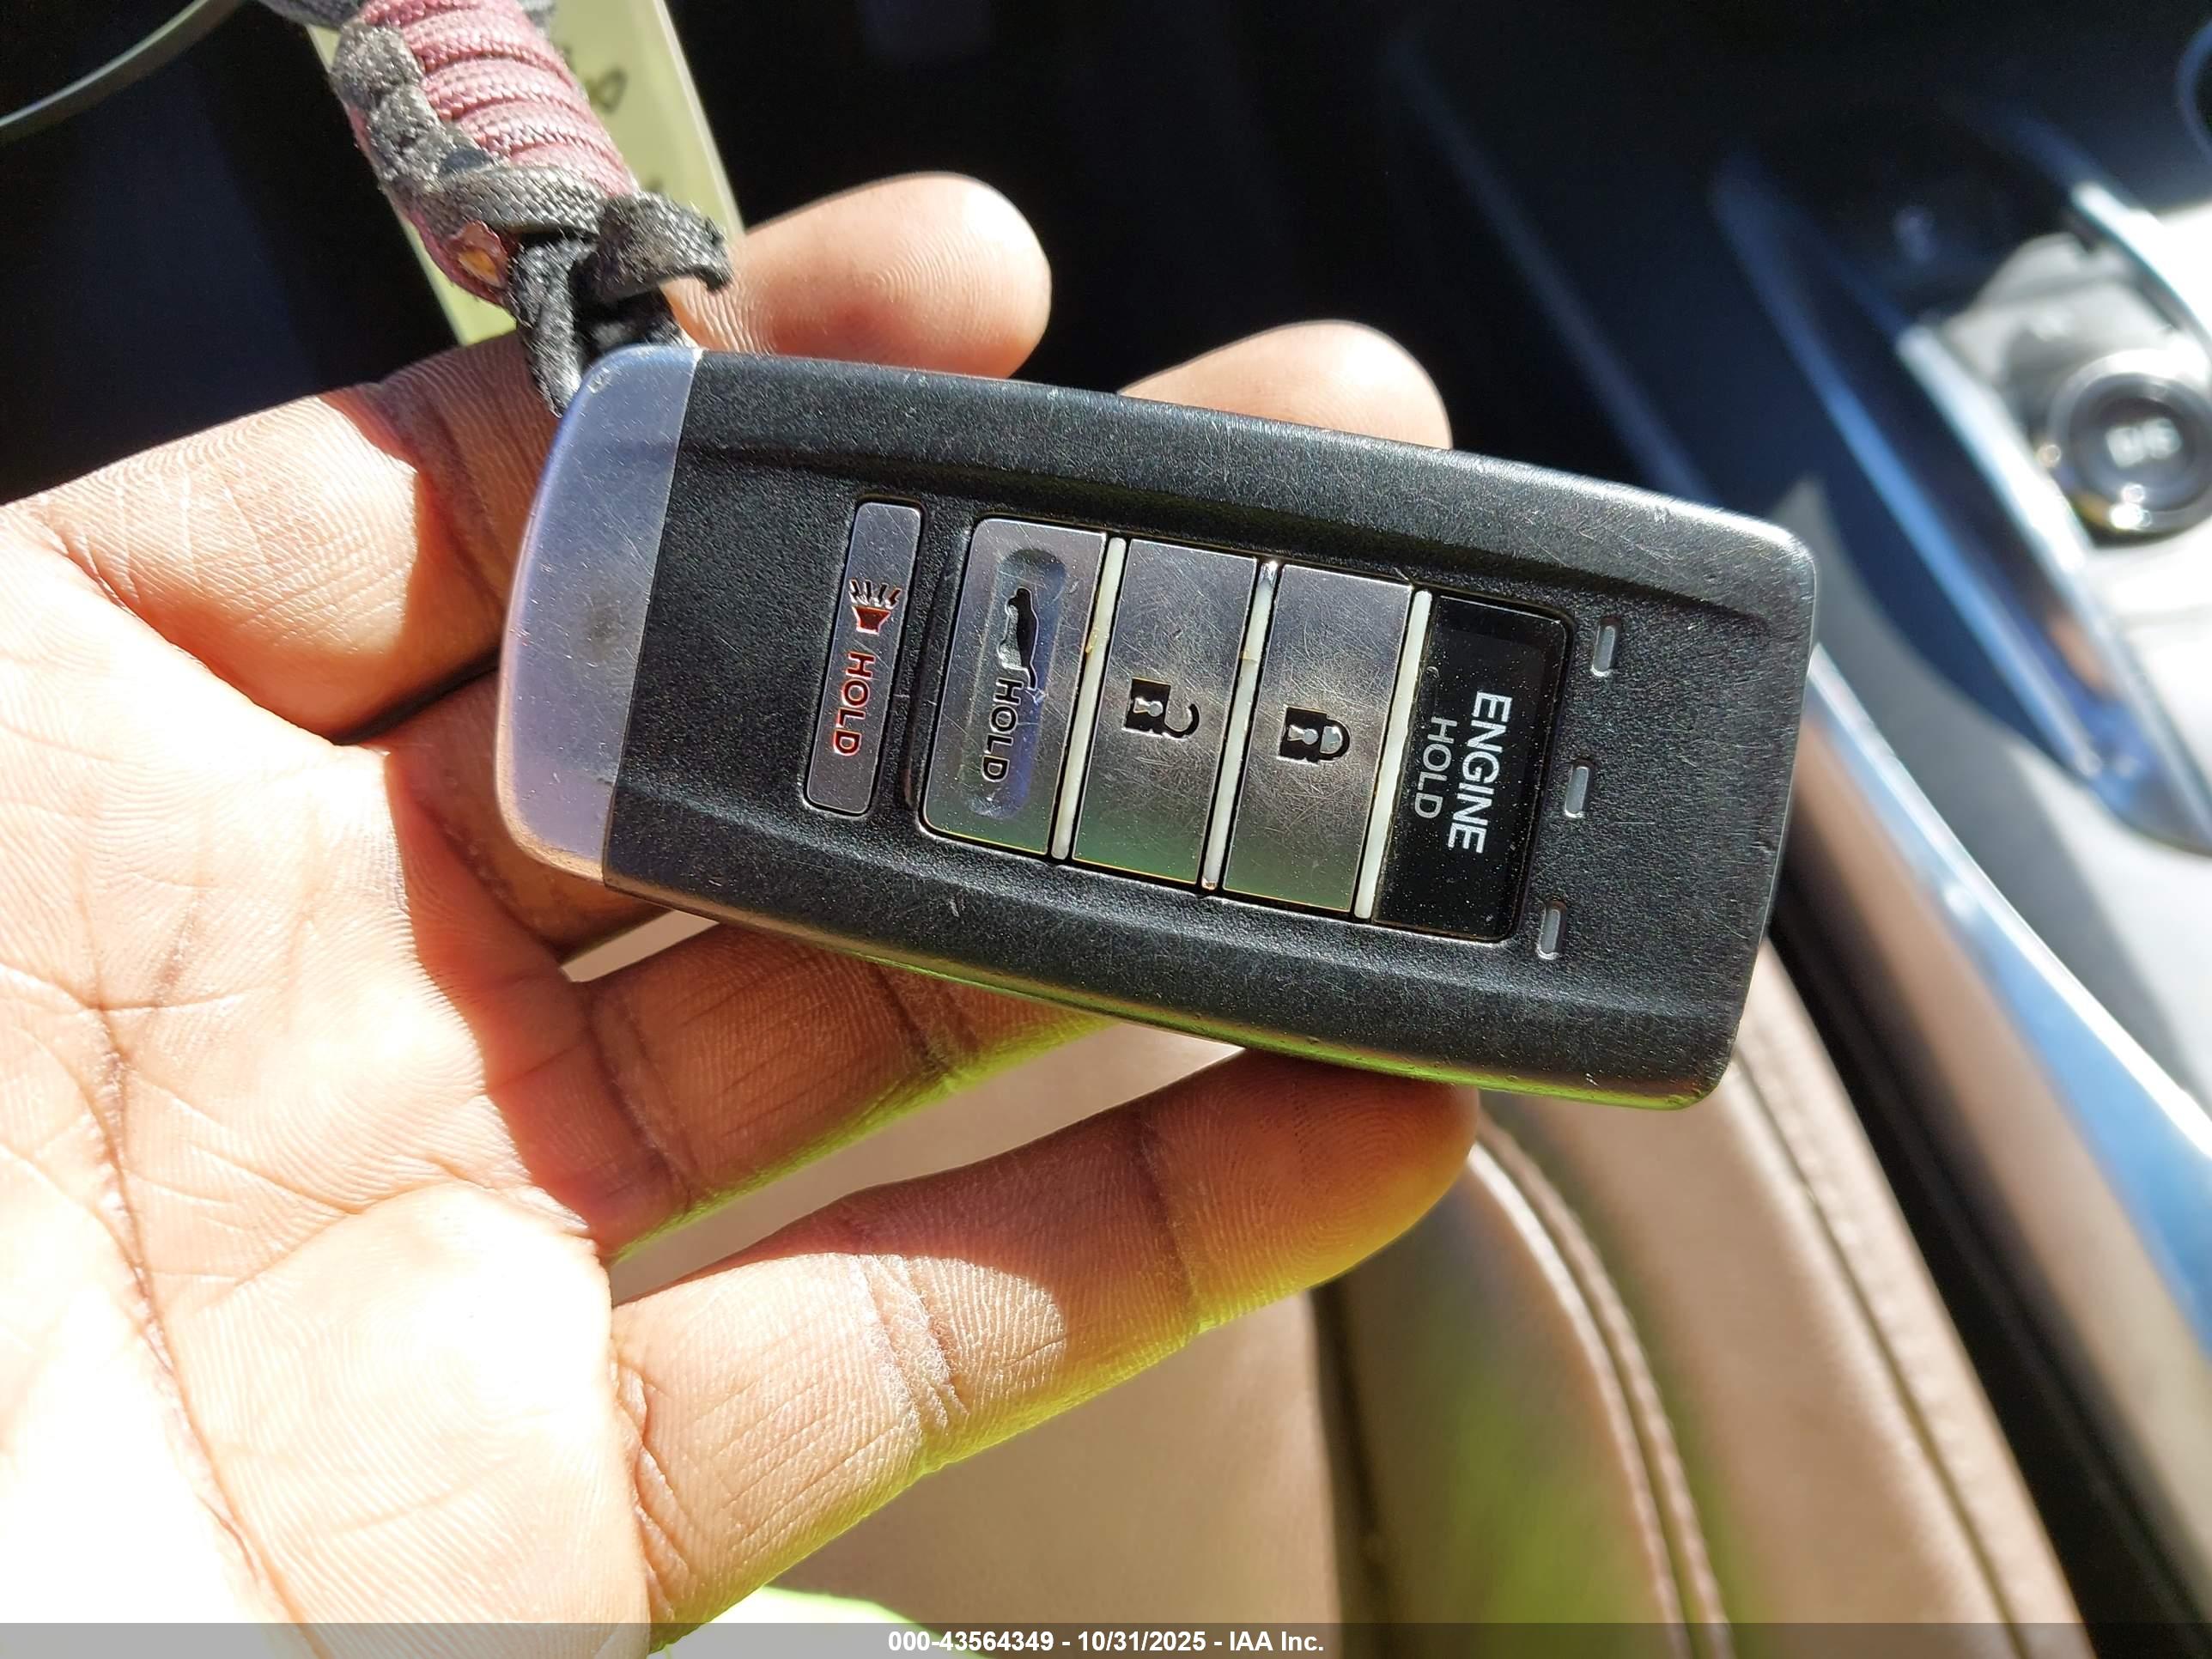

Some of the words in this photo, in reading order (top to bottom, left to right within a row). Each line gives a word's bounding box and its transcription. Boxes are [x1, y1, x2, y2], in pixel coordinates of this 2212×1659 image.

[834, 651, 876, 757] HOLD
[981, 677, 1024, 783] HOLD
[1414, 715, 1458, 819] HOLD
[1447, 690, 1512, 854] ENGINE
